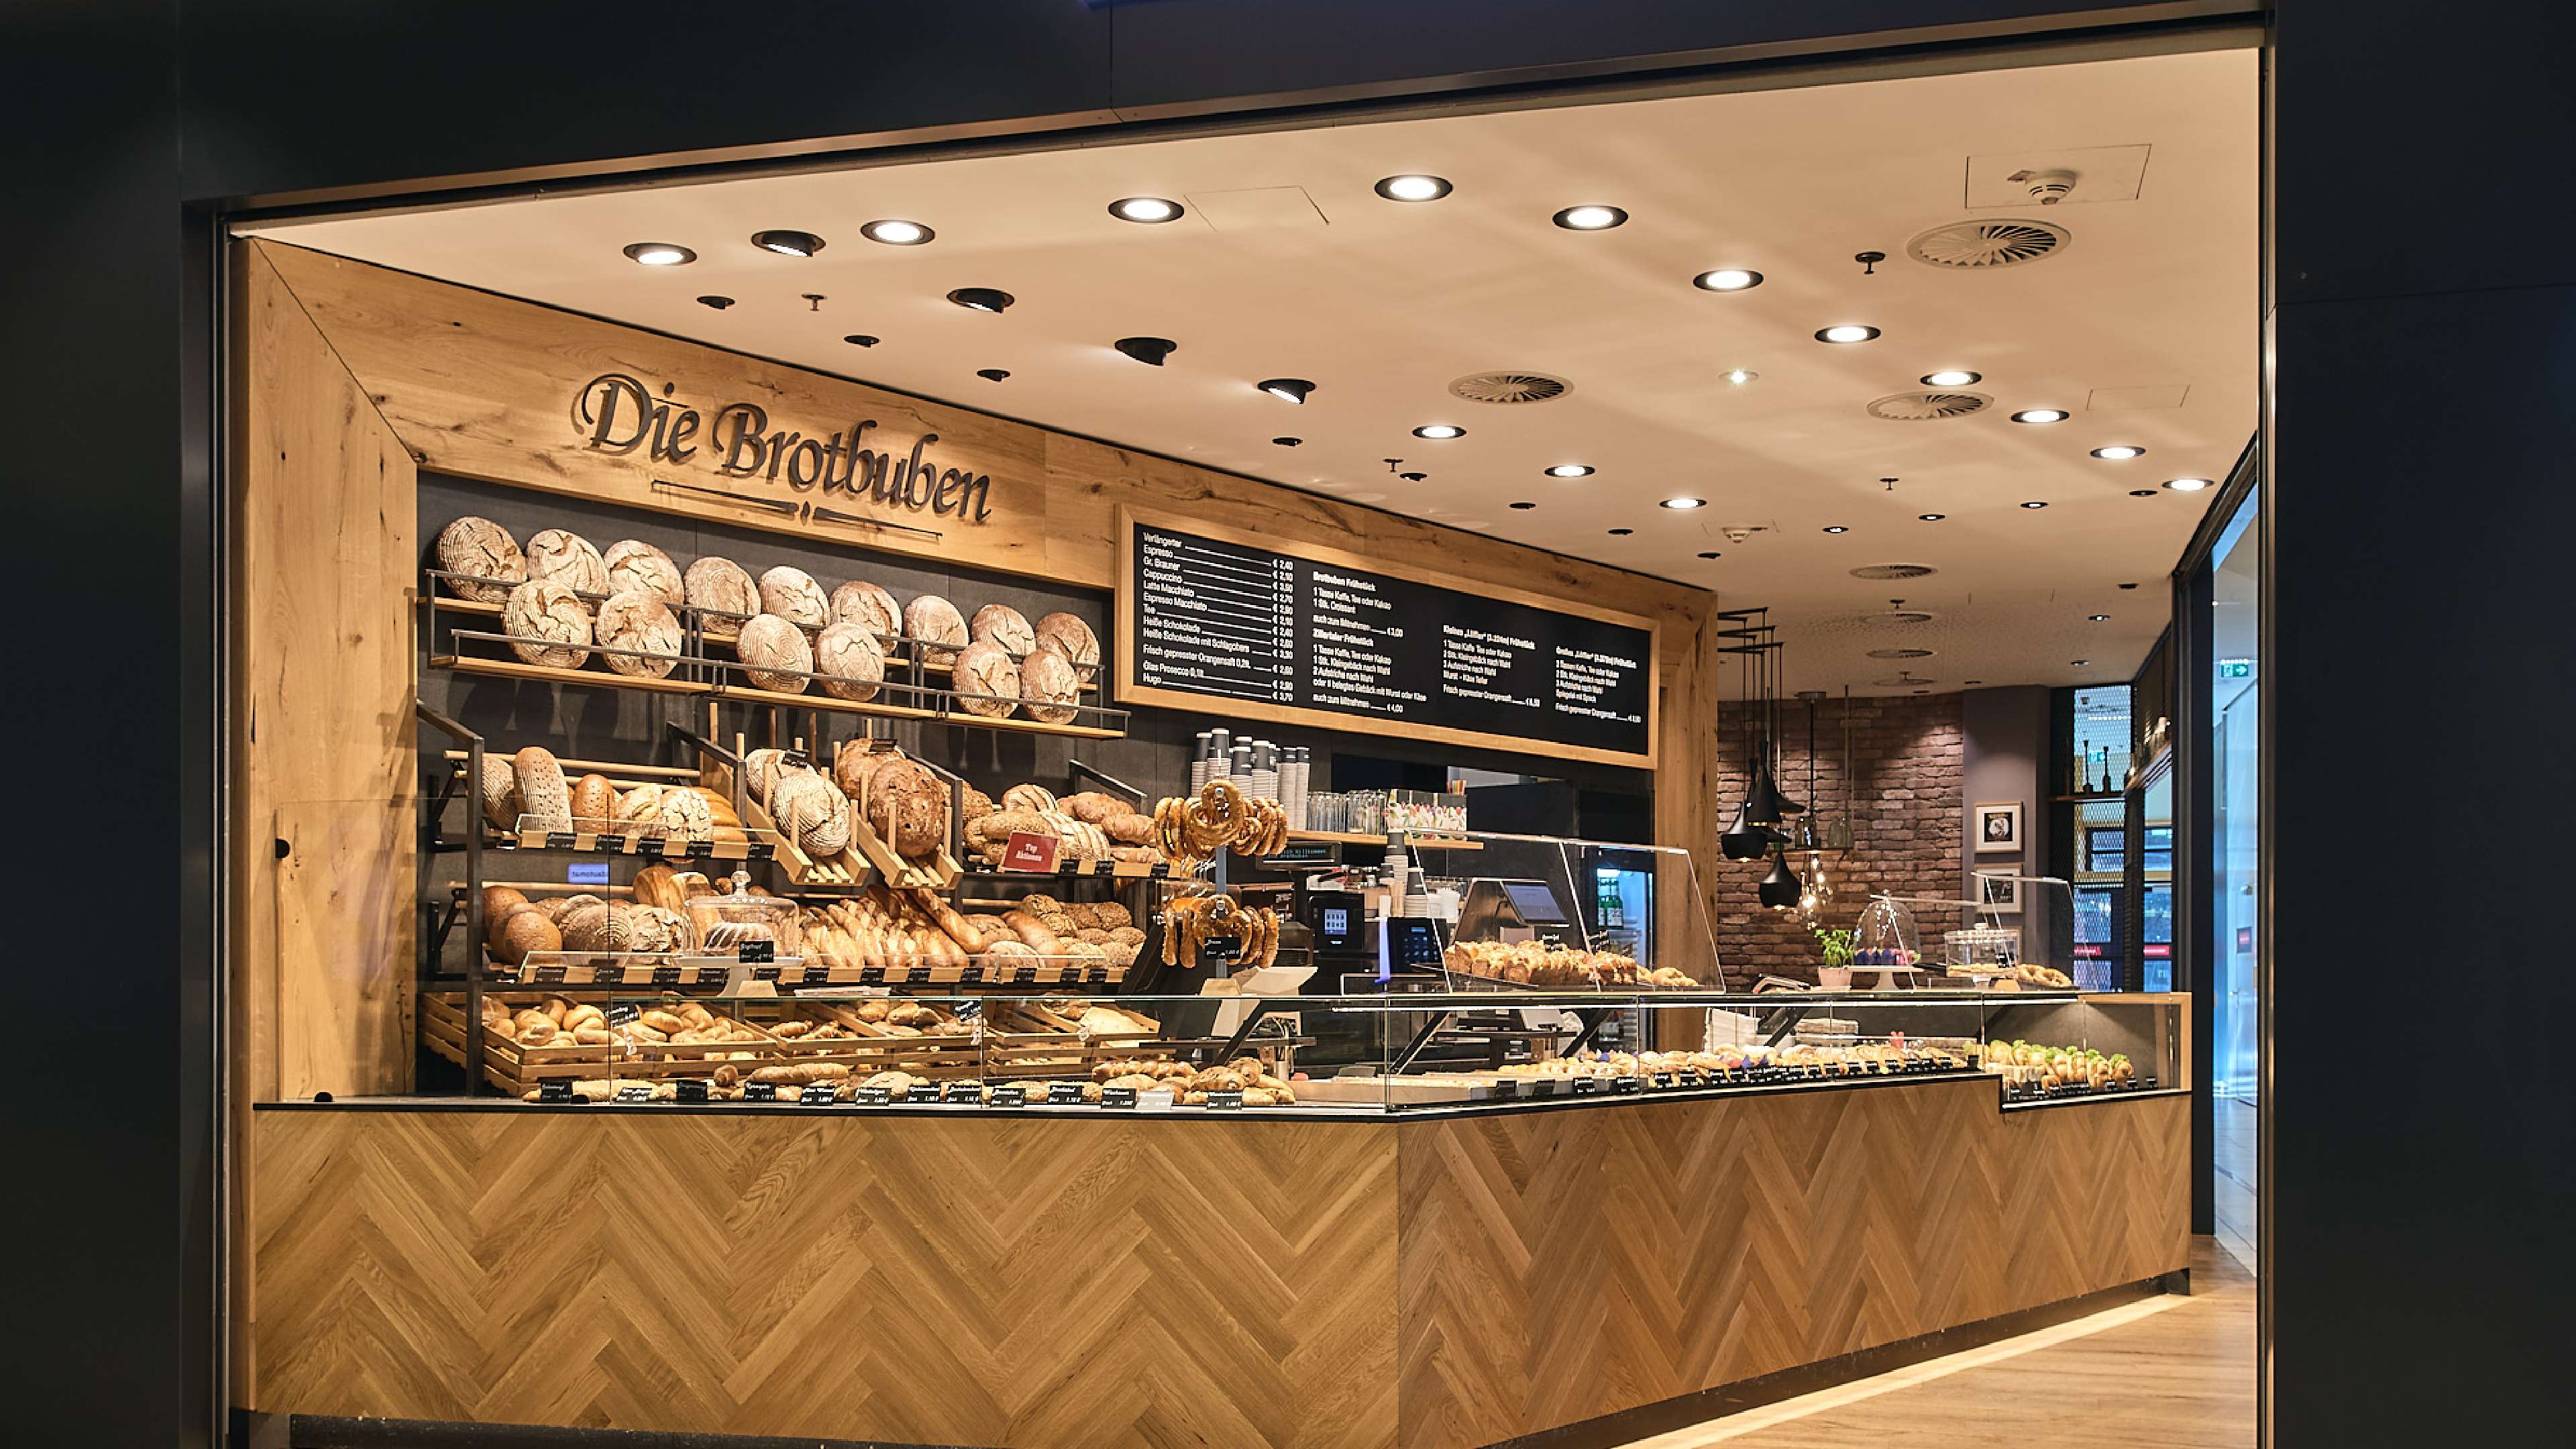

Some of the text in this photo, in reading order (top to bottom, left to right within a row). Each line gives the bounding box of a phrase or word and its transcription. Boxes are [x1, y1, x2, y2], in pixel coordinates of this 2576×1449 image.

[581, 373, 991, 521] Die Brotbuben
[1144, 544, 1173, 557] Espresso
[1154, 557, 1180, 571] Brauner
[1142, 568, 1183, 583] Cappuccino
[1143, 580, 1160, 591] Latte
[1161, 582, 1194, 597] Macchiato
[1346, 578, 1376, 591] Frühstück
[1143, 590, 1173, 605] Espresso
[1173, 596, 1207, 611] Macchiato
[1318, 586, 1334, 598] Tasse
[1350, 594, 1360, 604] Tee
[1361, 596, 1374, 606] oder
[1374, 599, 1391, 610] Kakao
[1142, 603, 1156, 614] Tee
[1142, 614, 1163, 627] Heiße
[1163, 619, 1201, 634] Schokolade
[1313, 614, 1326, 624] auch
[1326, 616, 1339, 626] zum
[1340, 617, 1371, 631] Mitnehmen
[1142, 627, 1162, 639] Heiße
[1163, 630, 1199, 645] Schokolade
[1200, 637, 1211, 646] mit
[1212, 637, 1249, 653] Schlagobers
[1343, 633, 1373, 647] Frühstück
[1142, 643, 1163, 655] Frisch
[1163, 649, 1197, 660] gepresster
[1197, 651, 1235, 666] Orangensaft
[1318, 644, 1334, 655] Tasse
[1350, 650, 1360, 659] Tee
[1361, 653, 1373, 662] oder
[1373, 654, 1391, 665] Kakao
[1142, 659, 1159, 672] Glas
[1159, 663, 1189, 676] Prosecco
[1362, 664, 1376, 673] nach
[1377, 665, 1390, 675] Wahl
[1142, 672, 1161, 686] Hugo
[1346, 672, 1359, 681] nach
[1360, 672, 1373, 683] Wahl
[1312, 677, 1326, 687] oder
[1401, 691, 1413, 699] oder
[1413, 692, 1427, 701] Käse
[1313, 694, 1327, 702] auch
[1327, 695, 1339, 704] zum
[1340, 695, 1369, 708] Mitnehmen
